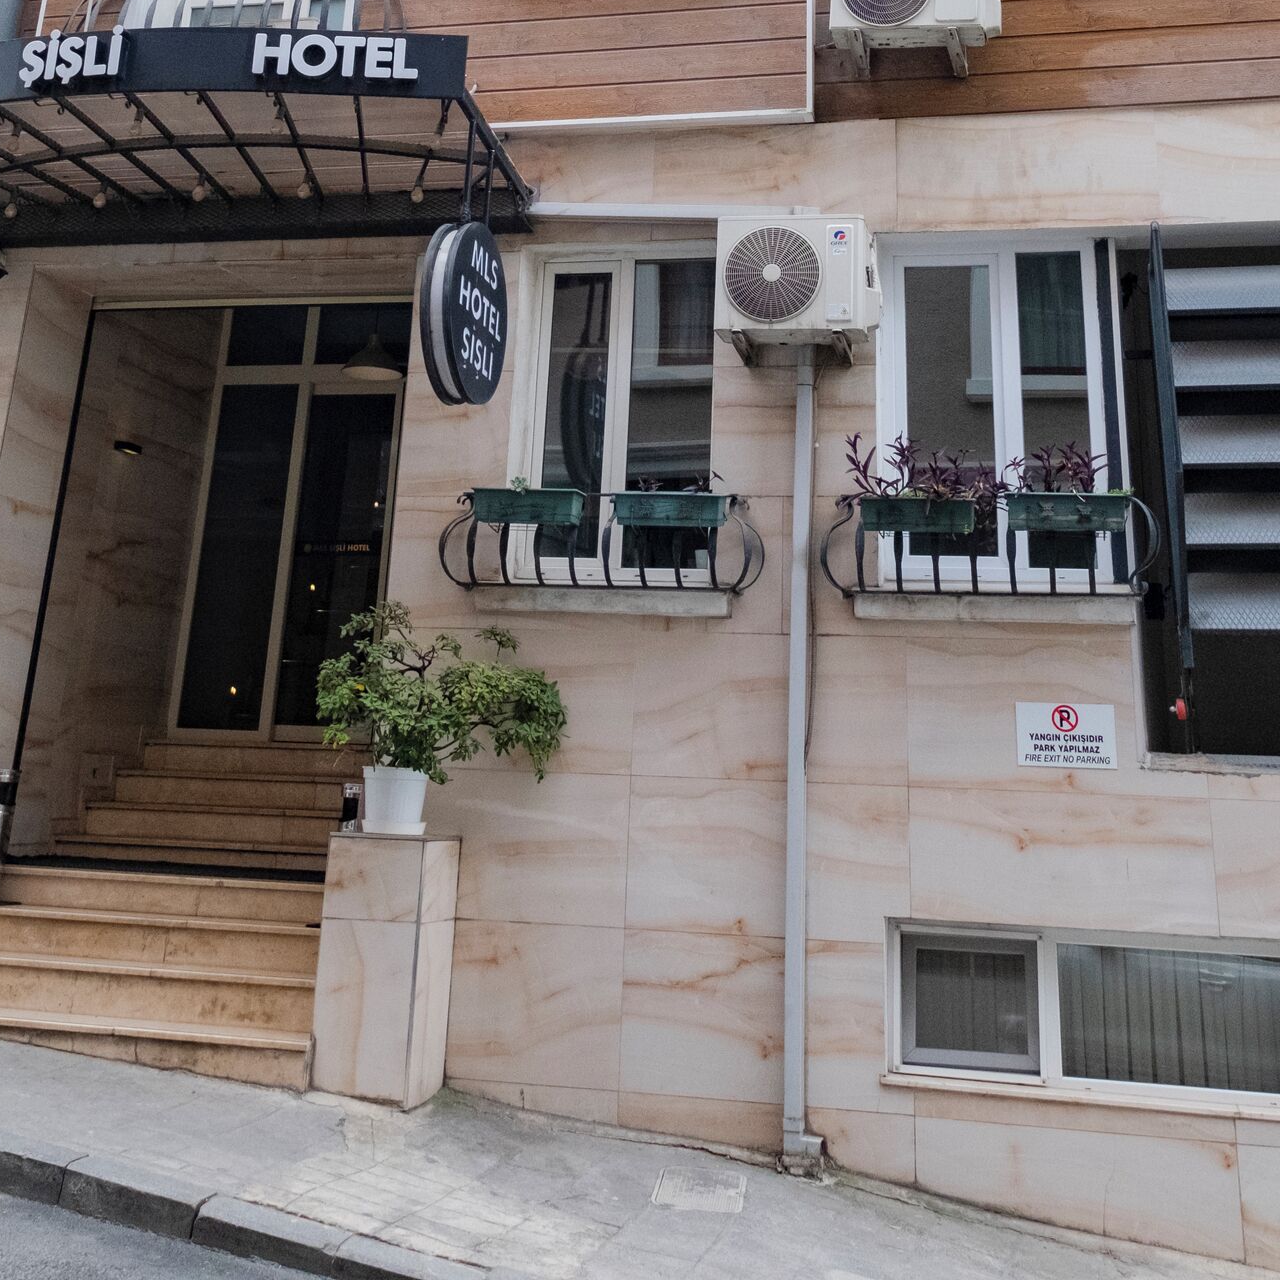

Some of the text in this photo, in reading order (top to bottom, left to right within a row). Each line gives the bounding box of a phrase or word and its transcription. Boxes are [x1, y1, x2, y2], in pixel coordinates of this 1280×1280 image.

[18, 24, 124, 89] ŞİŞLİ
[251, 32, 419, 80] HOTEL
[470, 239, 499, 291] MLS
[459, 274, 501, 343] HOTEL
[460, 325, 495, 381] ŞİŞLİ
[1024, 753, 1111, 765] FIRE EXIT NO PARKING
[1029, 733, 1104, 744] YANGIN ÇIKIŞIDIR
[1033, 743, 1101, 754] PARK YAPILMAZ
